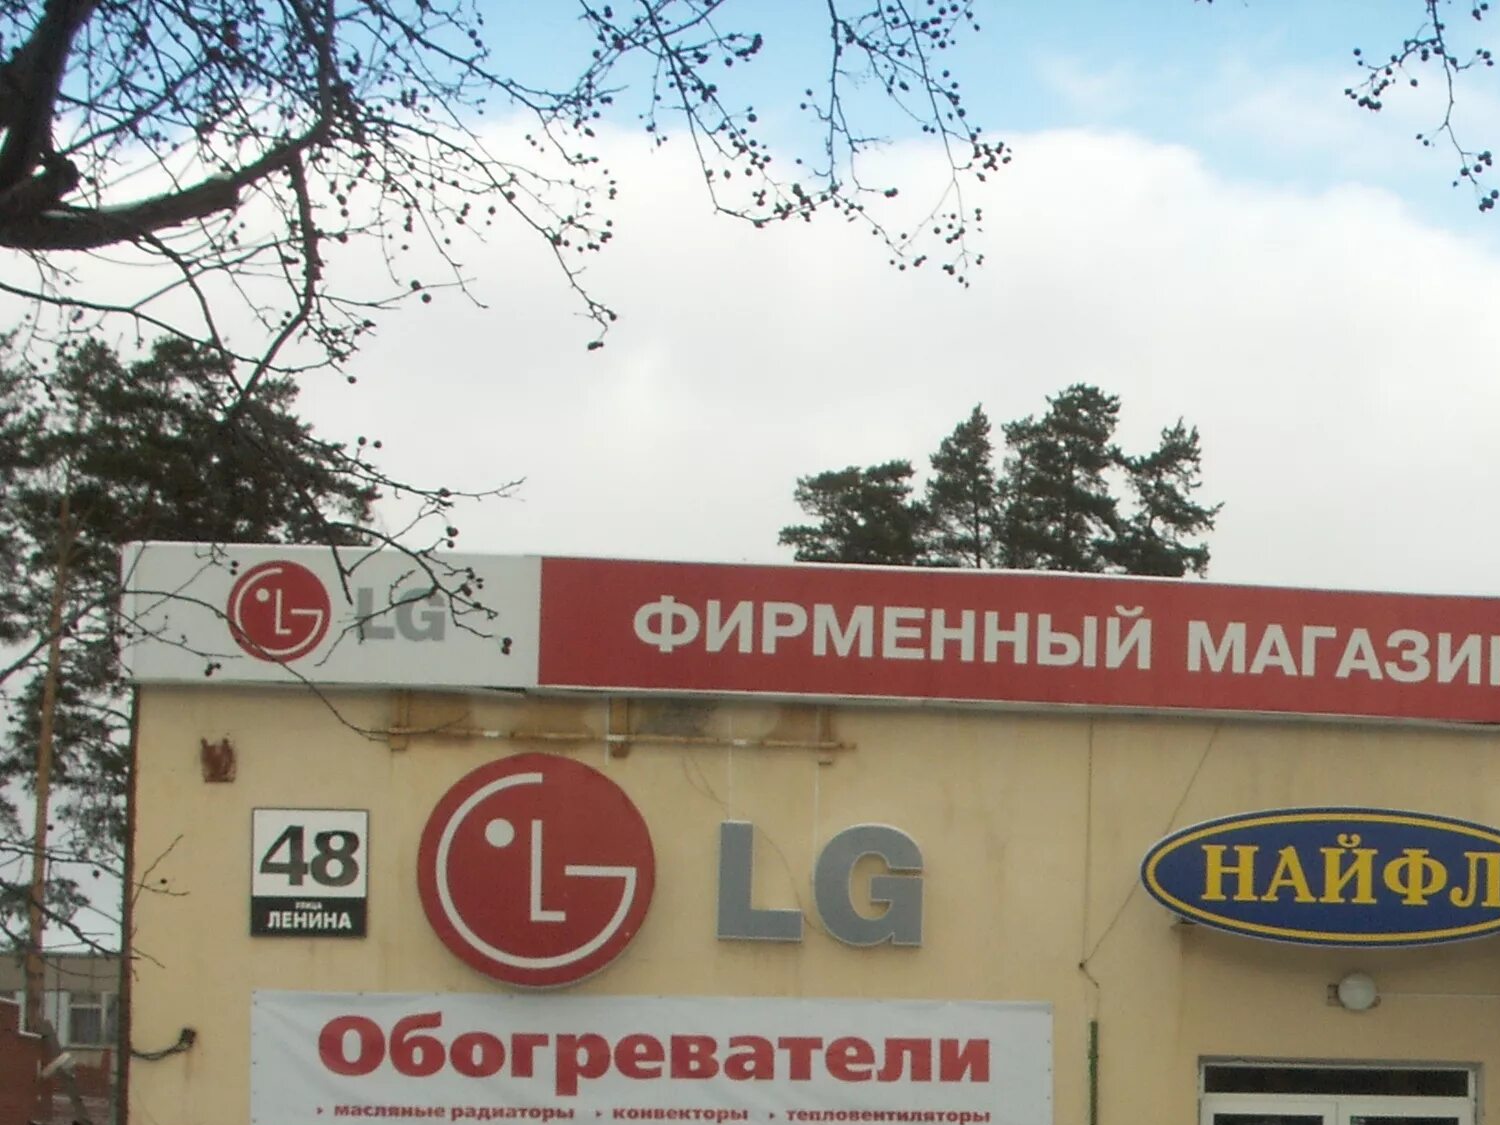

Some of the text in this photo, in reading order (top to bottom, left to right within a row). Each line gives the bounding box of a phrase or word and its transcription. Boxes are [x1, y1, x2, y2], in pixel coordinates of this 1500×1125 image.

[356, 586, 447, 643] LG
[633, 595, 1152, 670] ФИРМЕННЫЙ
[260, 825, 360, 887] 48
[716, 818, 924, 947] LG
[267, 910, 353, 929] ЛЕНИНА
[318, 1012, 990, 1097] Обогреватели
[334, 1103, 991, 1125] масляные радиаторы конвекторы тепловентиляторы
